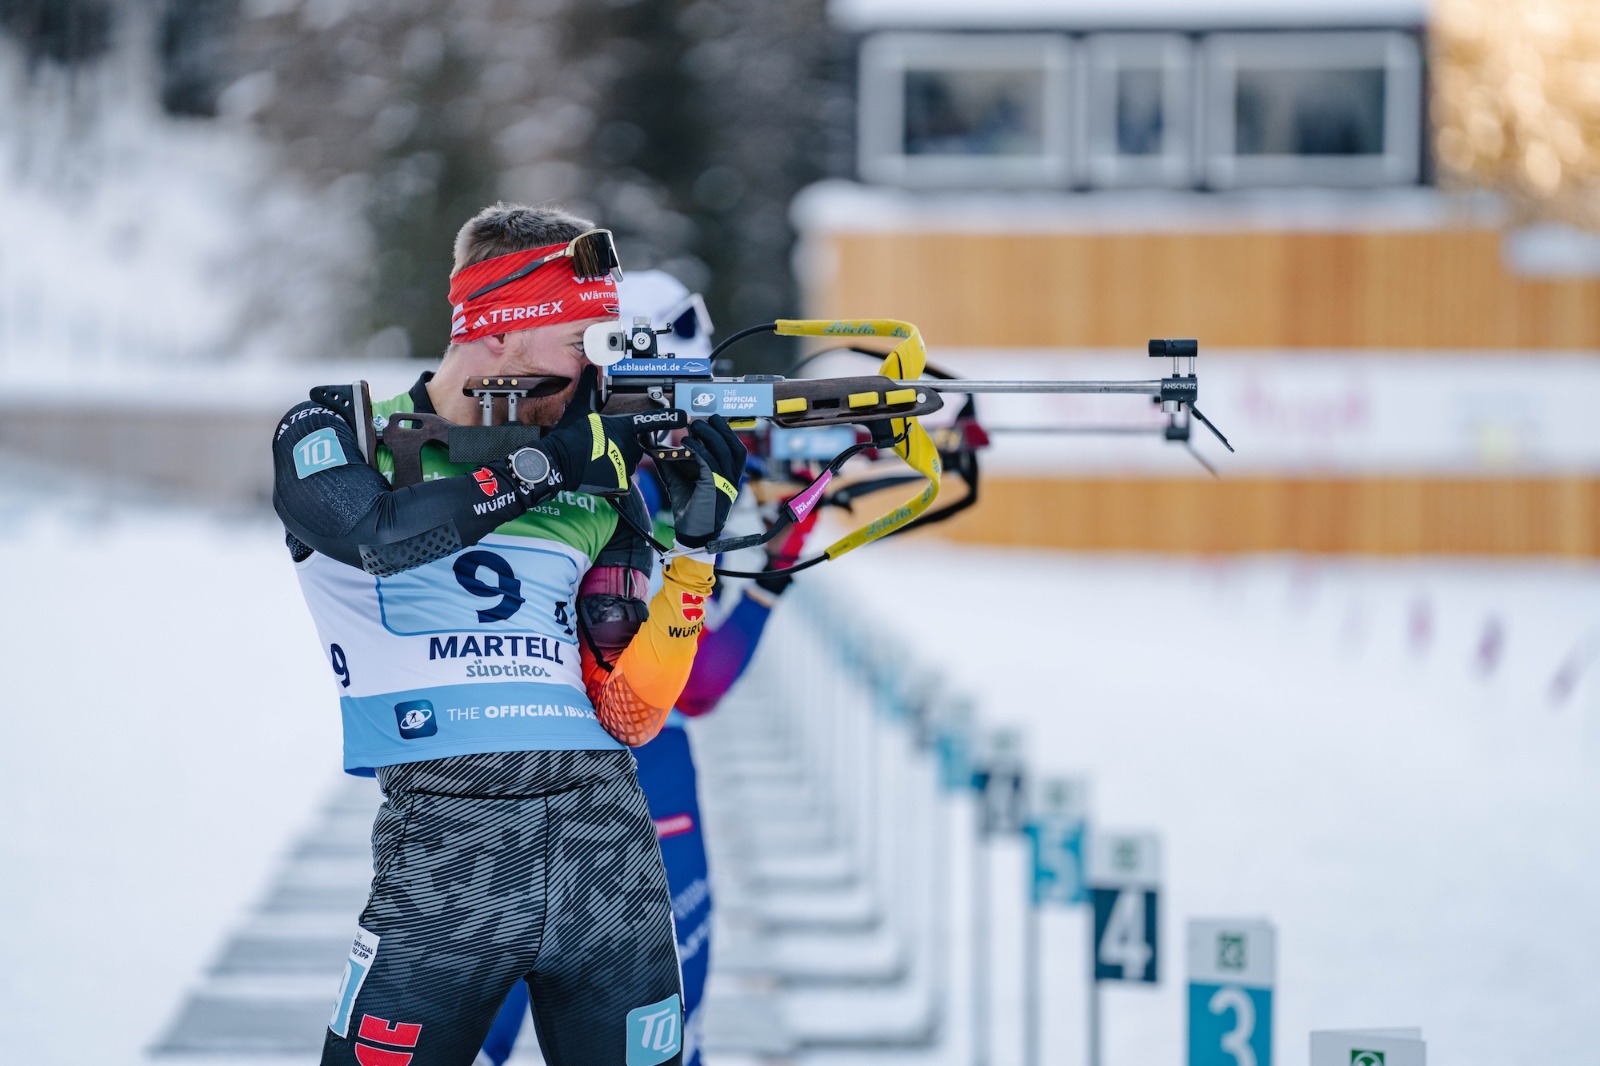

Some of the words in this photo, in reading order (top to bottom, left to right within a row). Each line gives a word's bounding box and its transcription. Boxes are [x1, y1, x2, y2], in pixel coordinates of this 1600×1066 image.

[490, 300, 563, 323] TERREX
[612, 359, 680, 371] dasblaueland.de
[298, 435, 338, 465] TQ
[452, 550, 526, 623] 9
[330, 643, 350, 688] 9
[429, 635, 563, 665] MARTELL
[447, 707, 480, 721] THE
[484, 704, 562, 718] OFFICIAL
[563, 705, 585, 718] IBU
[1100, 884, 1152, 979] 4
[638, 1007, 677, 1054] TQ
[1208, 985, 1258, 1066] 3
